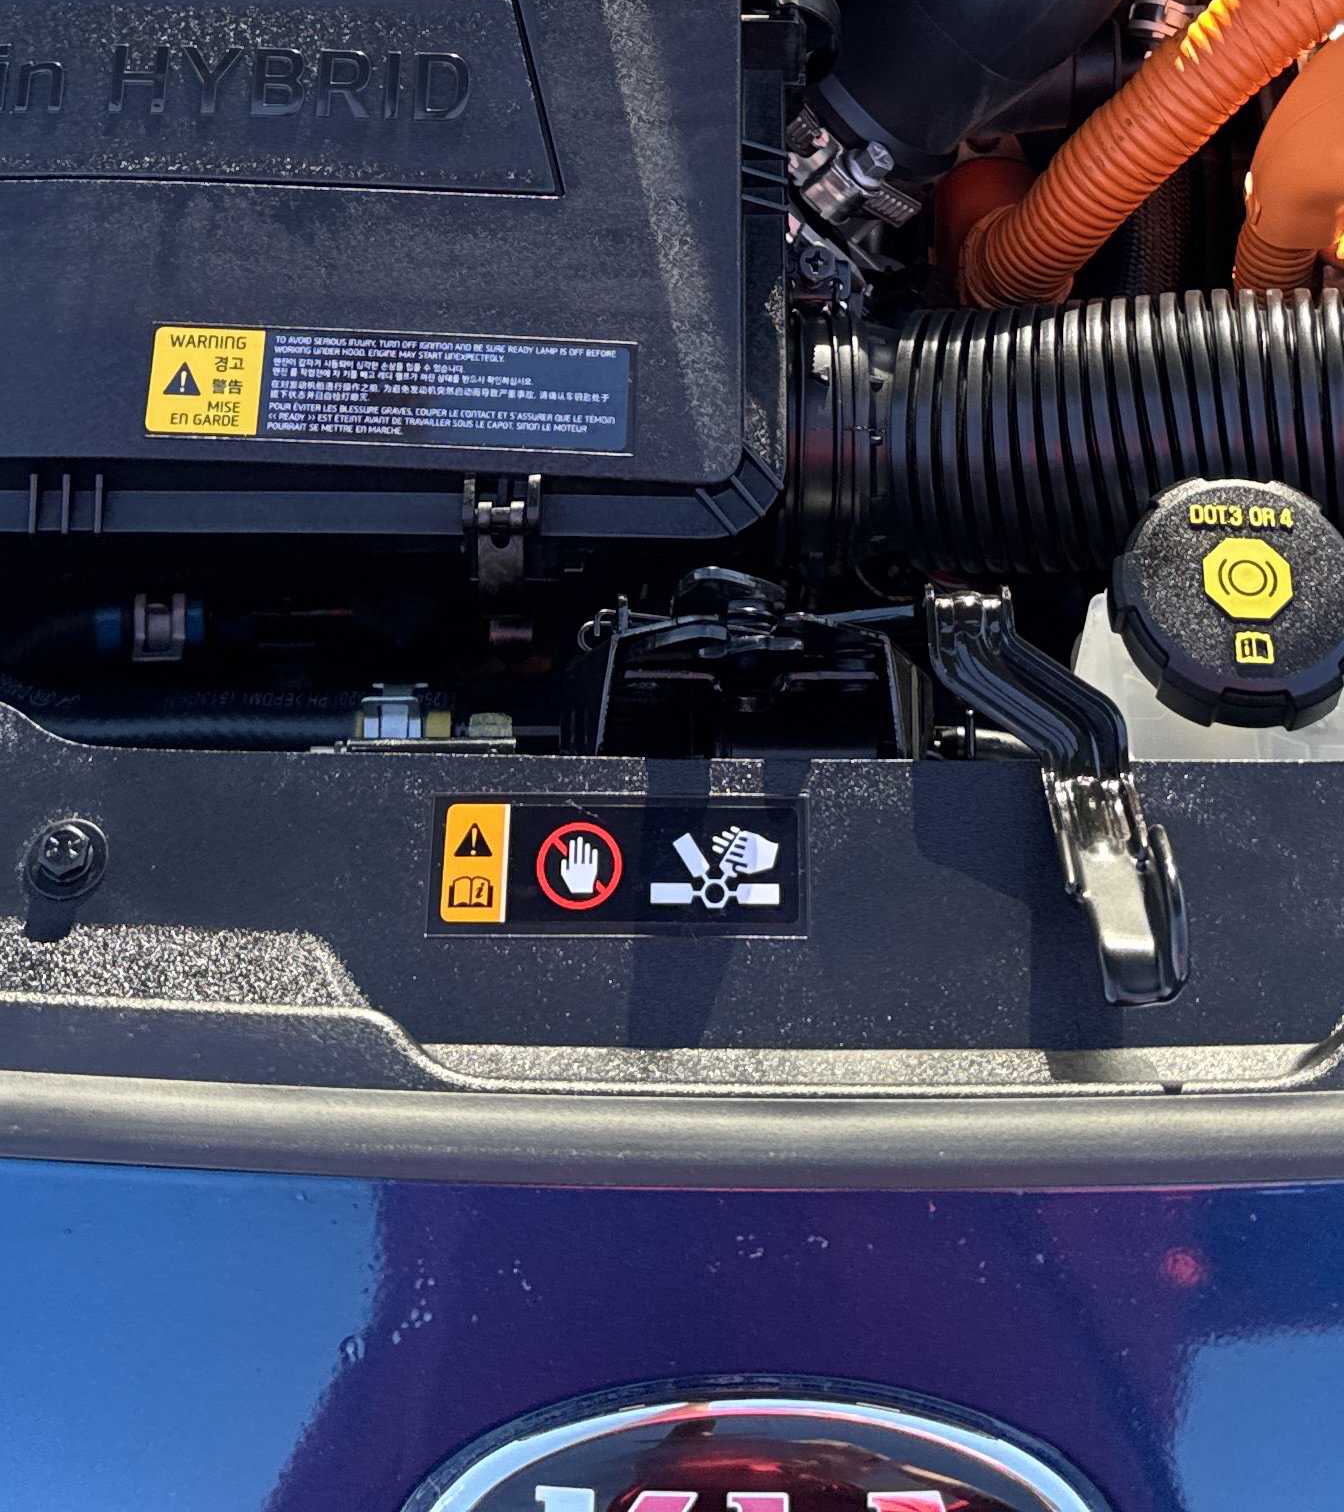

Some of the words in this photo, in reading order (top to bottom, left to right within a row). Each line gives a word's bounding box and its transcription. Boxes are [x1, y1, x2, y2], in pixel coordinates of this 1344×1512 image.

[106, 42, 473, 123] HYBRID
[170, 334, 247, 350] WARNING
[276, 336, 286, 344] TO
[288, 336, 312, 345] AVOID
[314, 337, 346, 347] SERIOUS
[379, 340, 399, 349] TURN
[402, 341, 417, 350] OFF
[419, 342, 452, 351] IGNITION
[455, 343, 471, 352] AND
[474, 344, 484, 352] BE
[486, 345, 506, 353] SURE
[508, 346, 534, 355] READY
[536, 347, 558, 356] LAMP
[569, 348, 584, 357] OFF
[586, 349, 616, 358] BEFORE
[274, 346, 311, 355] WORKING
[313, 347, 340, 356] UNDER
[368, 349, 396, 358] ENGINE
[399, 351, 416, 359] MAY
[418, 351, 442, 360] START
[214, 356, 245, 372] 경고
[212, 379, 243, 395] 警告
[207, 401, 241, 414] MISE
[269, 403, 291, 412] POUR
[323, 405, 337, 413] LES
[339, 405, 379, 415] BLESSURE
[415, 408, 447, 418] COUPER
[449, 410, 458, 418] LE
[460, 410, 495, 420] CONTACT
[498, 412, 508, 420] ET
[554, 414, 570, 423] QUE
[573, 415, 583, 423] LE
[170, 413, 188, 425] EN
[193, 414, 239, 427] GARDE
[279, 413, 305, 422] READY
[318, 415, 332, 423] EST
[364, 416, 390, 425] AVANT
[392, 417, 402, 426] DE
[405, 418, 450, 427] TRAVAILLER
[453, 420, 474, 428] SOUS
[476, 421, 484, 429] LE
[553, 424, 588, 433] MOTEUR
[267, 423, 306, 432] POURRAIT
[309, 424, 319, 432] SE
[321, 425, 353, 434] METTRE
[356, 426, 366, 434] EN
[1248, 506, 1276, 528] OR
[1279, 507, 1294, 528] 4
